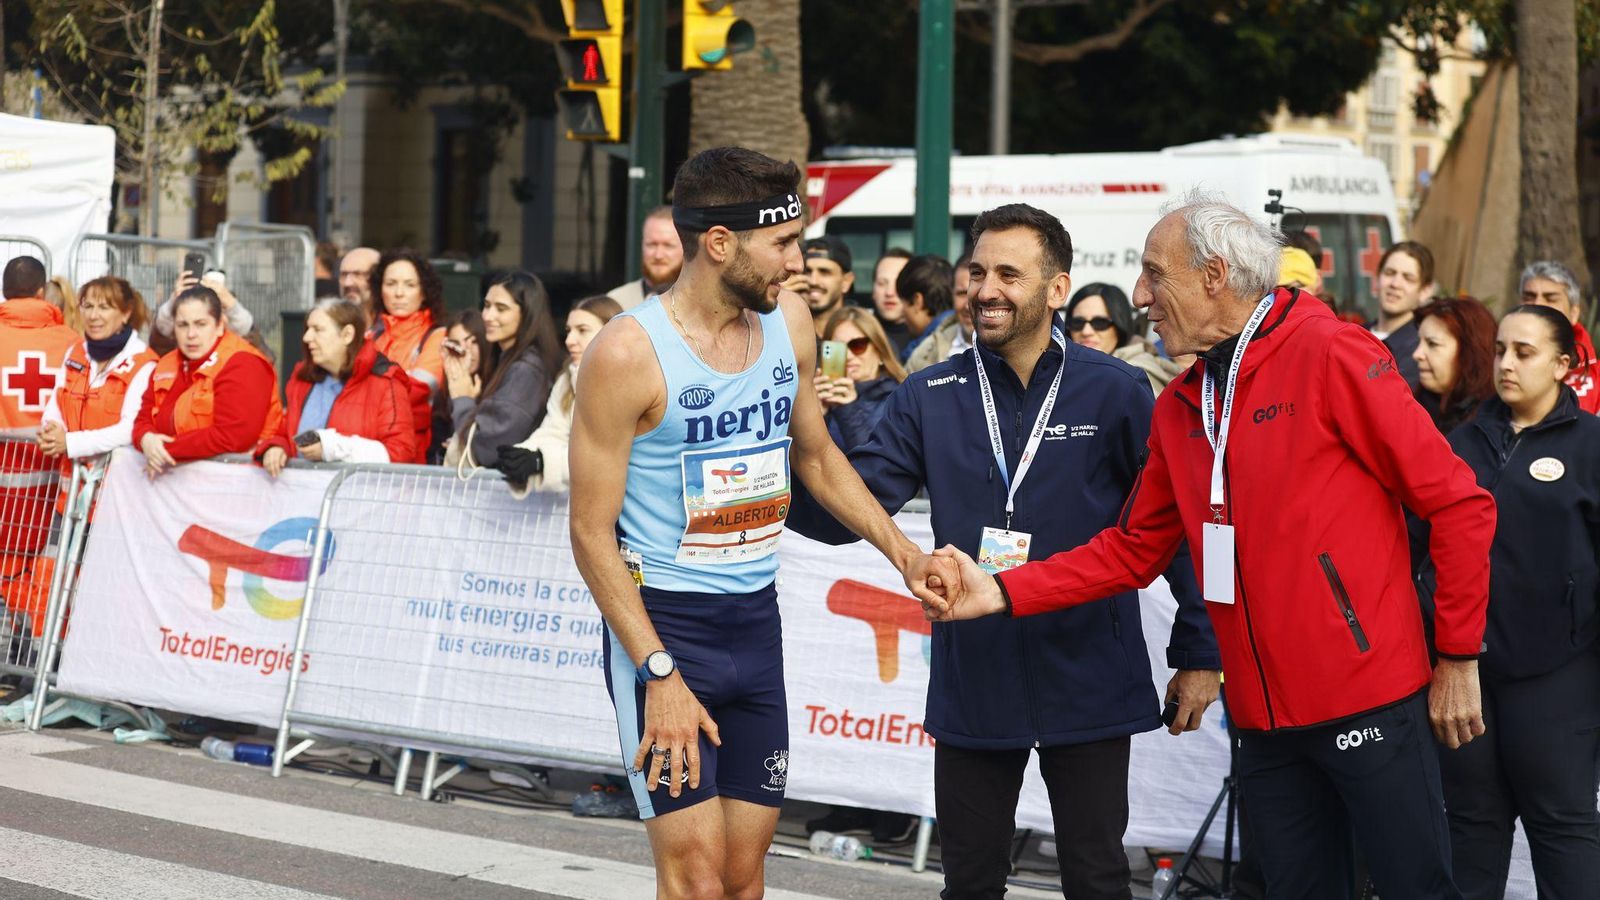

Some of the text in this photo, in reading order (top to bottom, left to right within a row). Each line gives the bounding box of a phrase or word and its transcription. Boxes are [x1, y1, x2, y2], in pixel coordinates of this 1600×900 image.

[927, 374, 957, 387] luanvi
[680, 389, 714, 406] TROPS
[683, 389, 792, 444] nerja
[713, 504, 776, 527] ALBERTO
[738, 530, 747, 545] 8
[461, 572, 526, 597] Somos
[534, 580, 552, 600] la
[159, 627, 310, 675] TotalEnergies
[438, 633, 463, 654] tus
[471, 639, 550, 665] carreras
[805, 704, 935, 748] TotalEn
[1336, 727, 1384, 750] GOfit
